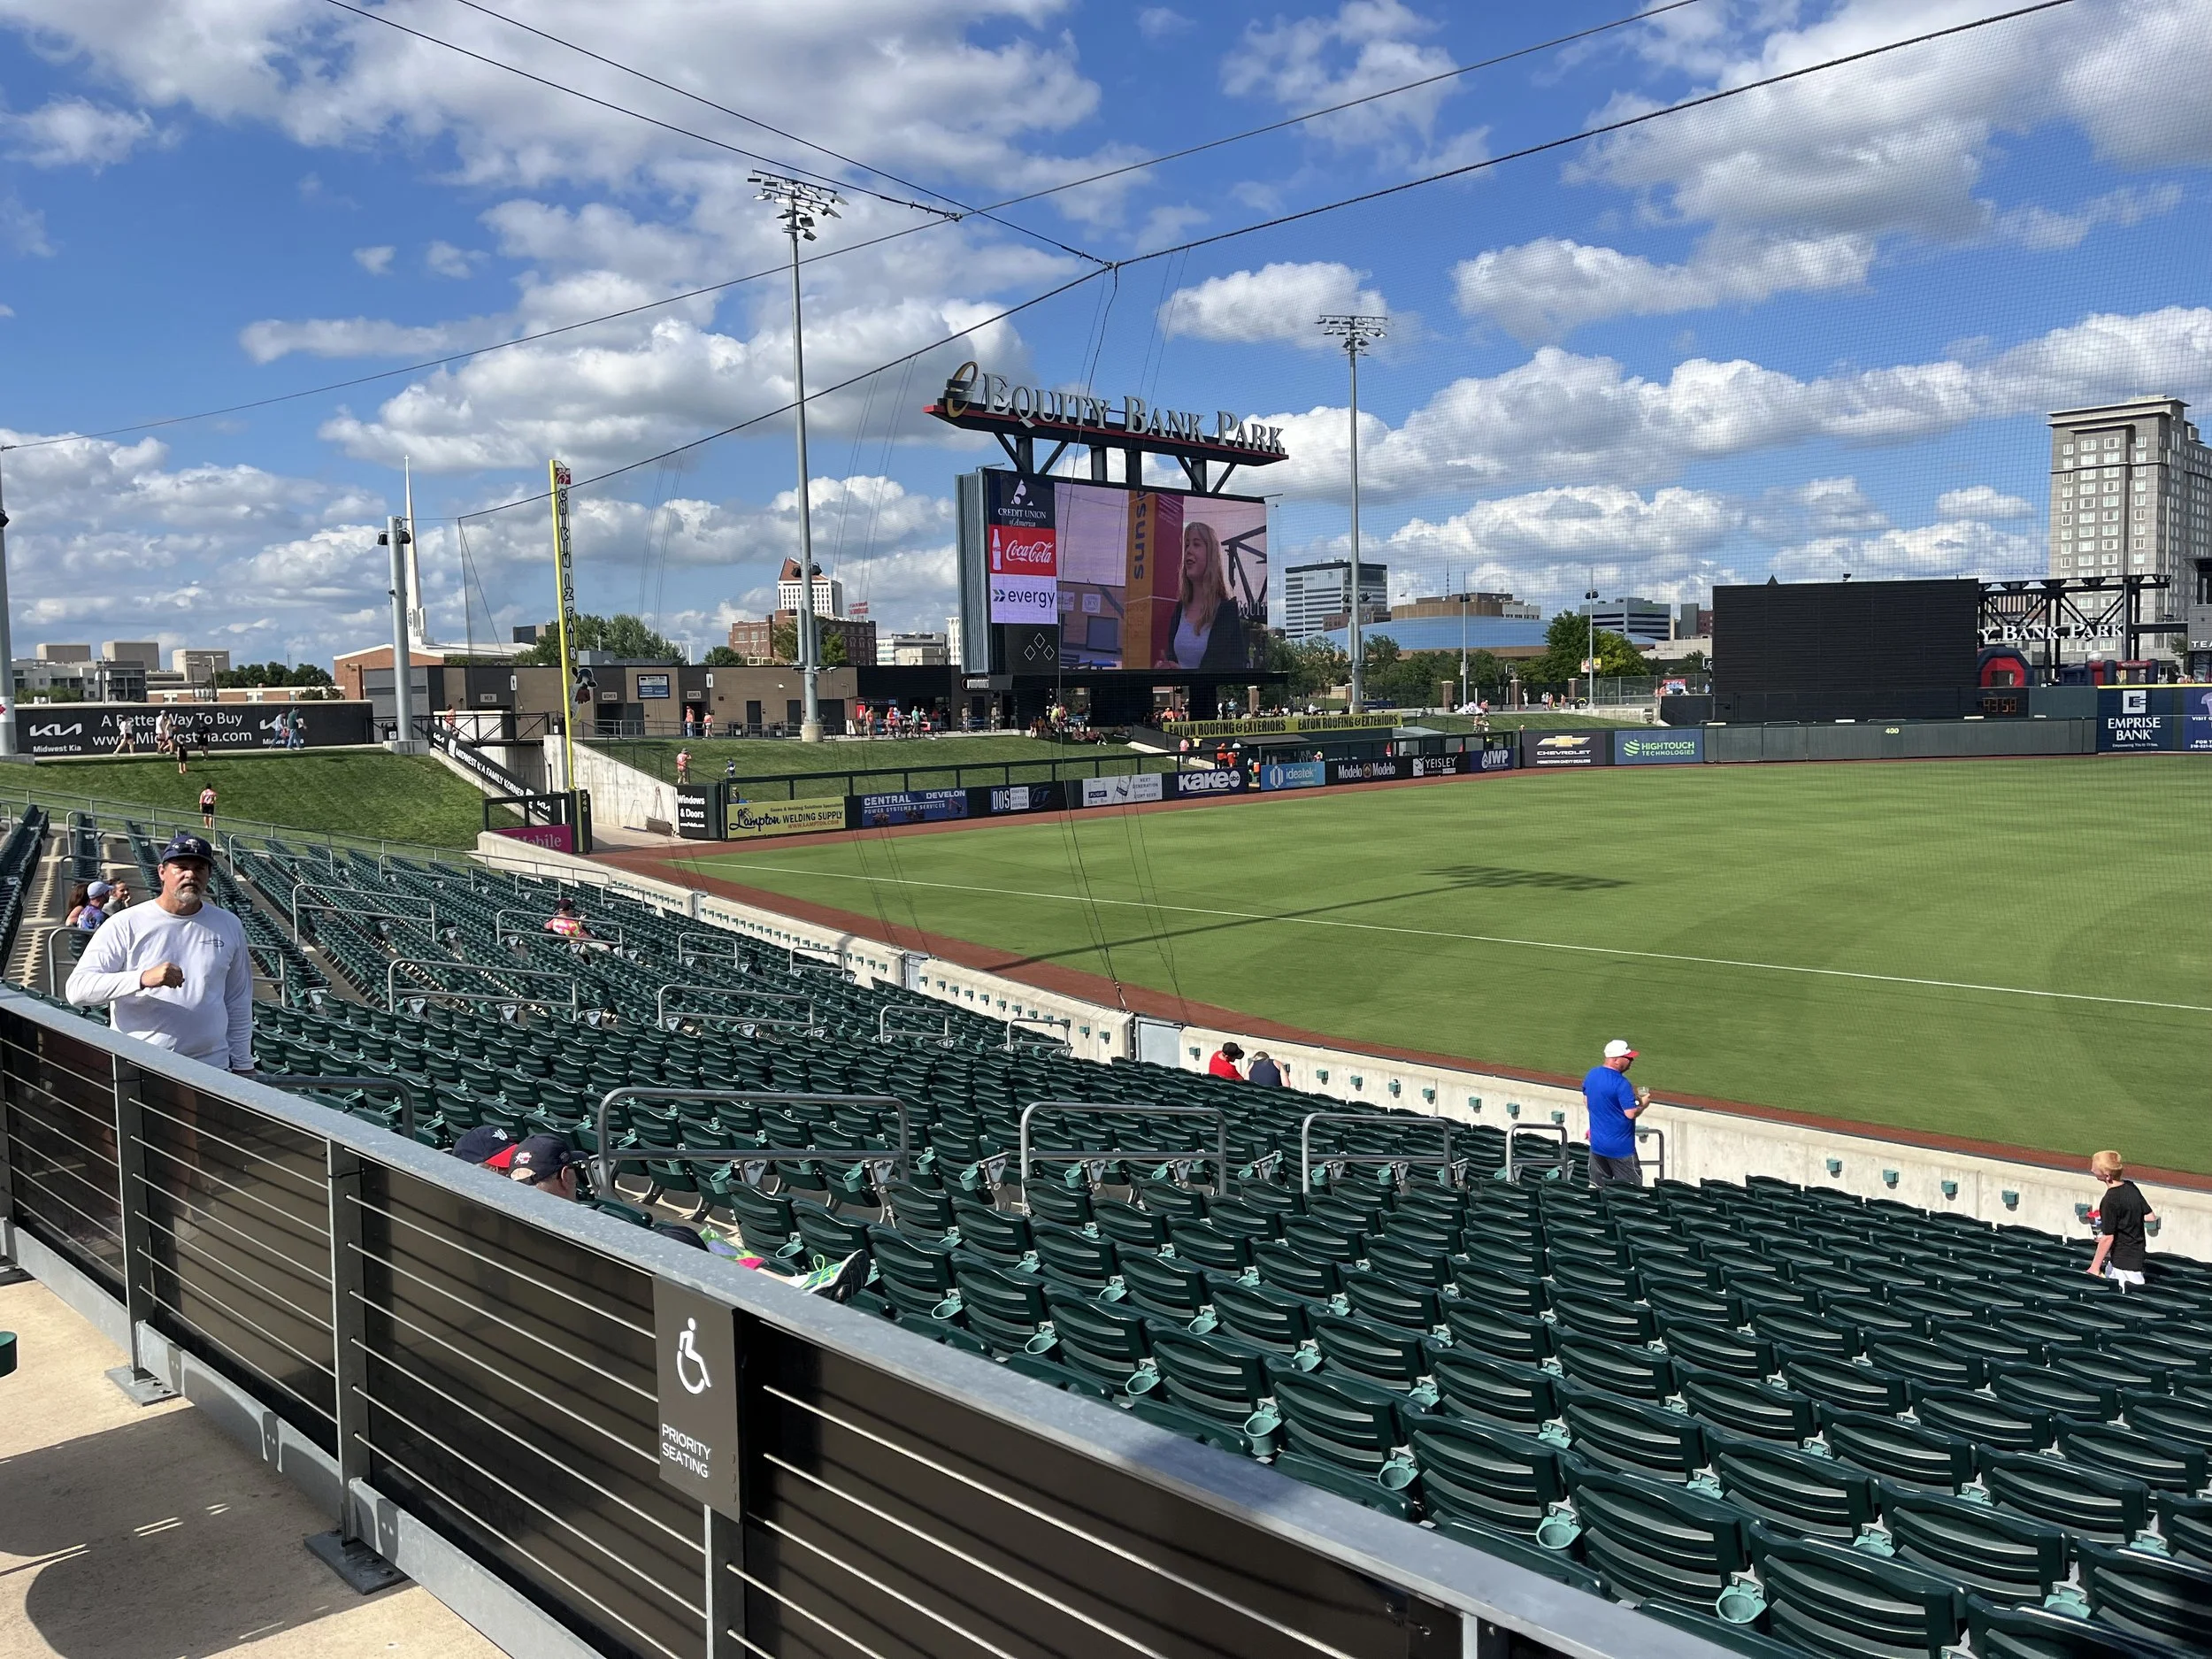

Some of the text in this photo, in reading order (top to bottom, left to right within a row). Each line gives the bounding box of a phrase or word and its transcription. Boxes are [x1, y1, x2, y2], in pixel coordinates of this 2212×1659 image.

[983, 373, 1110, 428] EQUITY
[1124, 396, 1205, 442] BANK
[1217, 411, 1285, 455] PARK
[998, 508, 1046, 519] CREDIT UNION
[1014, 518, 1036, 527] America
[558, 488, 577, 661] CHIKIN IZ FAIR
[1008, 589, 1055, 608] evergy
[2002, 626, 2060, 641] BANK
[2070, 624, 2124, 638] PARK
[101, 715, 111, 727] A
[196, 713, 213, 724] To
[217, 712, 242, 727] Buy
[1169, 723, 1195, 737] EATON
[1197, 721, 1234, 735] ROOFING
[1243, 719, 1286, 733] EXTERIORS
[1298, 716, 1321, 730] EATON
[1323, 716, 1354, 728] ROOFING
[1362, 714, 1398, 727] EXTERIORS
[2108, 718, 2161, 728] EMPRISE
[1425, 757, 1455, 769] YEISLEY
[1488, 749, 1509, 765] IWP
[456, 748, 478, 768] MIDWEST
[486, 767, 504, 785] FAMILY
[1286, 767, 1315, 780] ideatek
[1338, 762, 1395, 780] Modelo Modelo
[678, 795, 704, 805] Windows
[864, 790, 965, 806] CENTRAL DEVELON
[993, 789, 1010, 810] DOS
[686, 809, 704, 818] Doors
[729, 808, 843, 831] Lampton WELDING SUPPLY
[662, 1423, 711, 1461] PRIORITY
[662, 1442, 709, 1479] SEATING
